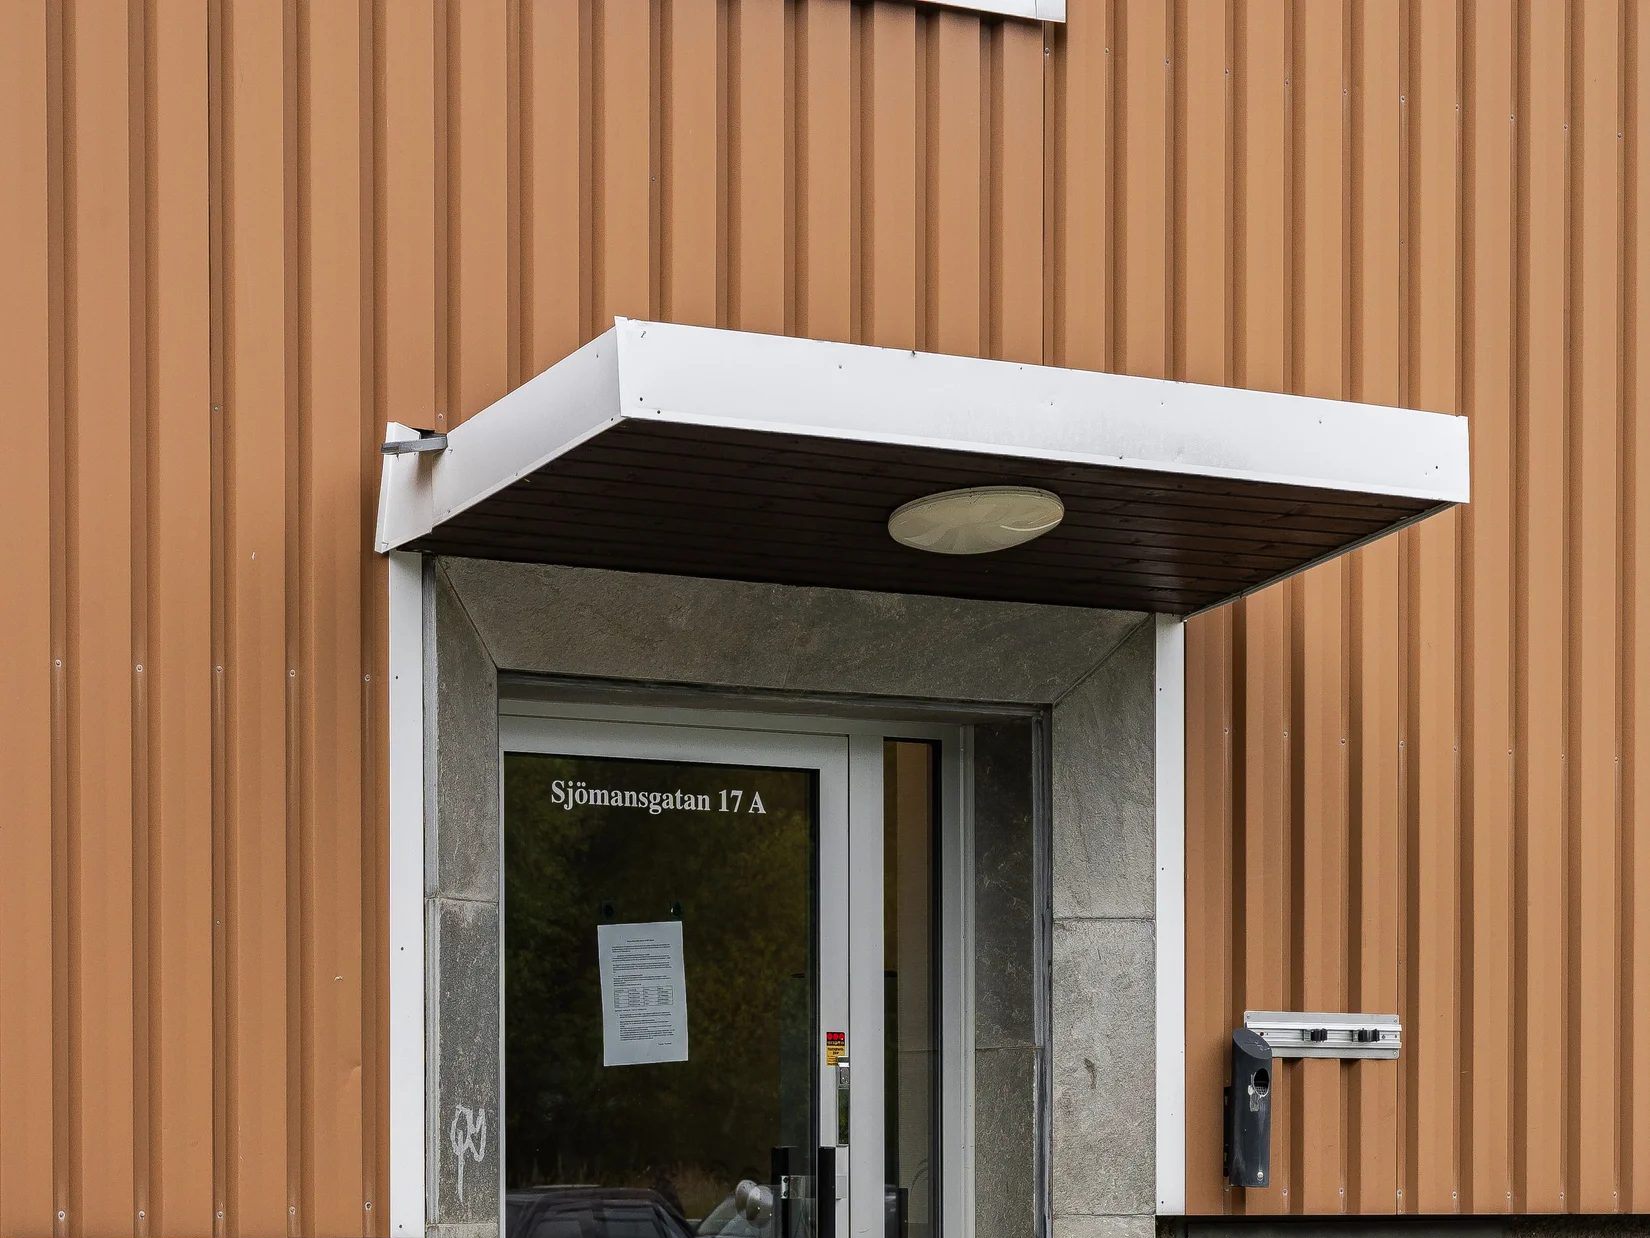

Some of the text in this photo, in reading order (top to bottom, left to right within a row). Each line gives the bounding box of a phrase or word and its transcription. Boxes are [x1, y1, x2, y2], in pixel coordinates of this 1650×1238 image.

[551, 779, 767, 815] Sjömansgatan 17 A
